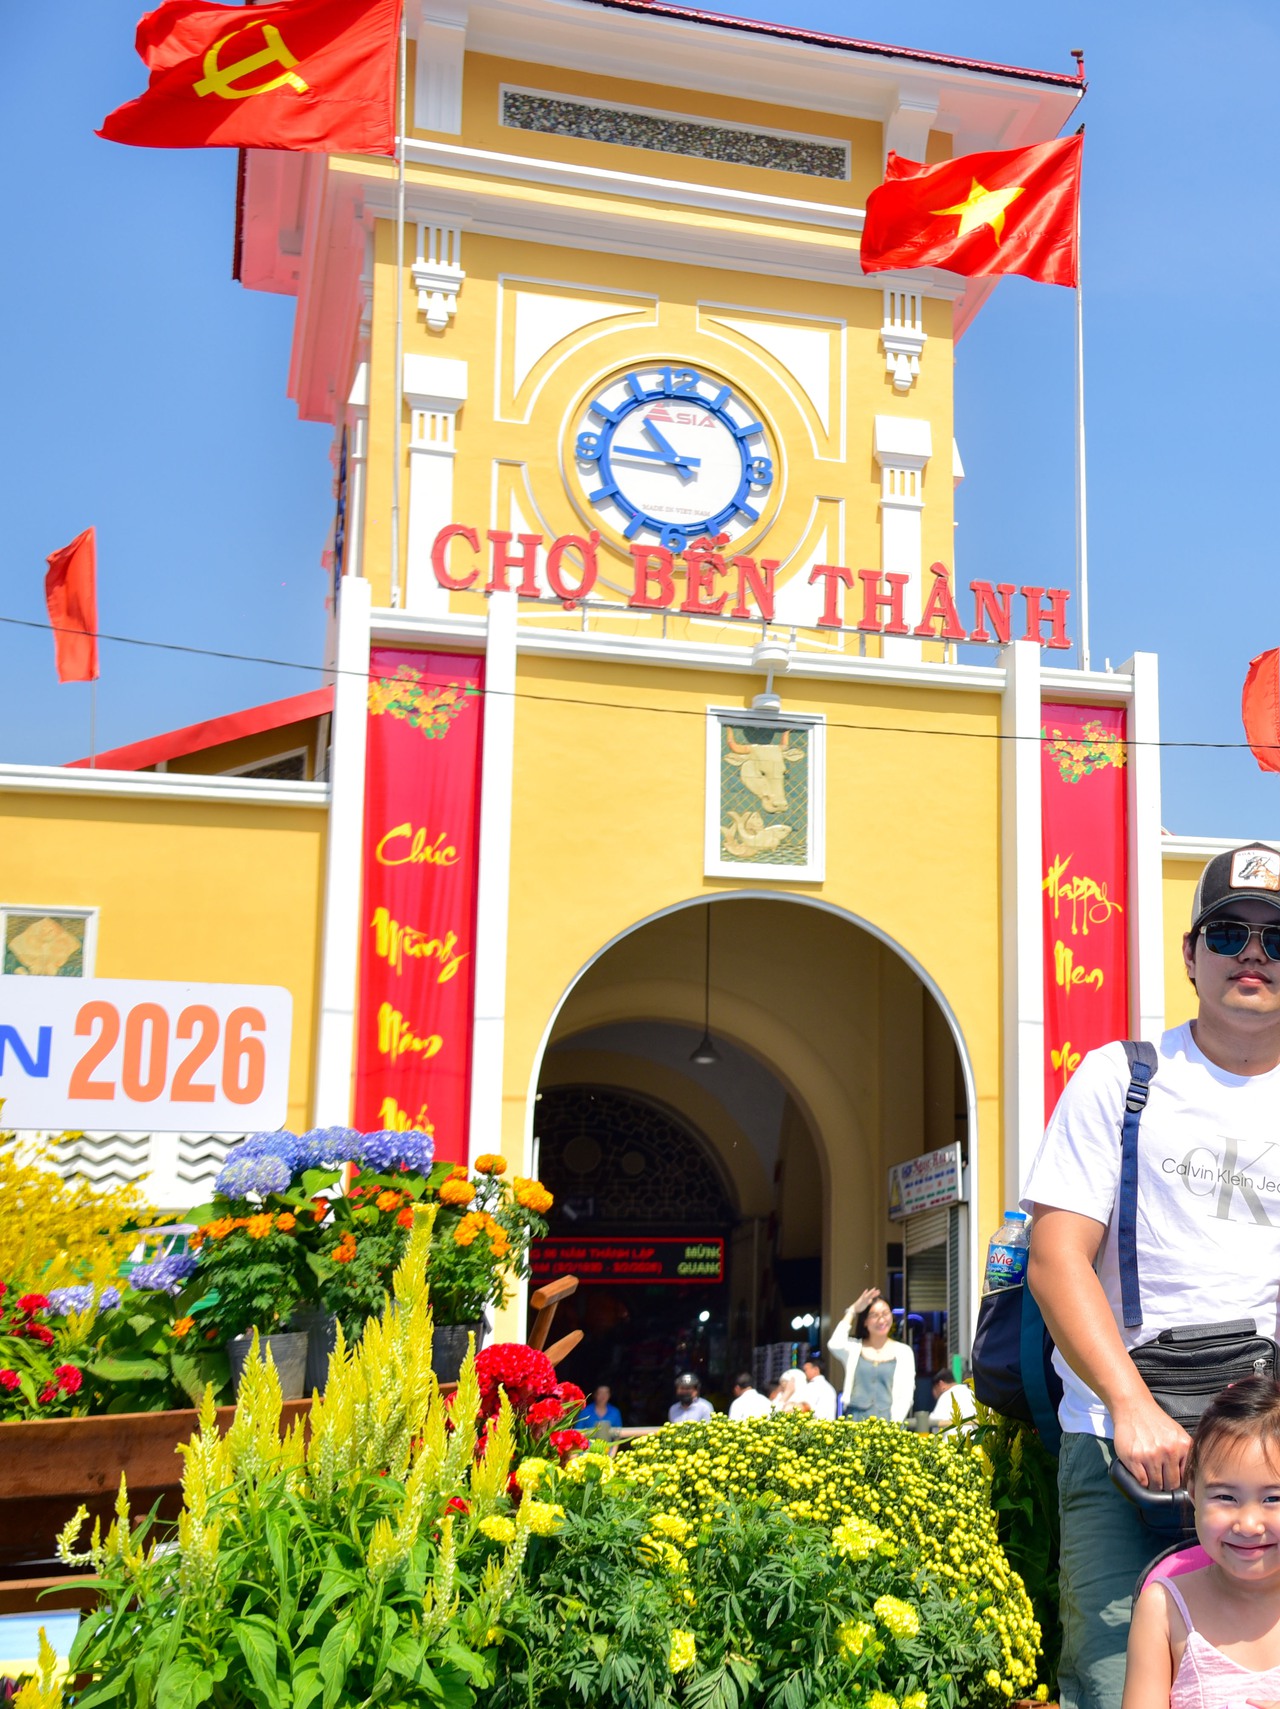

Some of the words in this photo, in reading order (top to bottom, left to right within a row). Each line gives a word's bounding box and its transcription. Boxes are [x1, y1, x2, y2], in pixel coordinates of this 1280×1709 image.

[658, 366, 701, 397] 12
[575, 431, 603, 460] 9
[748, 456, 774, 485] 3
[660, 523, 687, 553] 6
[431, 524, 599, 611] CHỢ
[629, 531, 780, 621] BẾN
[808, 561, 1072, 650] THÀNH
[376, 823, 461, 866] Chúc
[1042, 852, 1123, 935] Happy
[68, 1000, 267, 1105] 2026
[1162, 1158, 1214, 1181] Calvin
[1217, 1168, 1254, 1188] Klein
